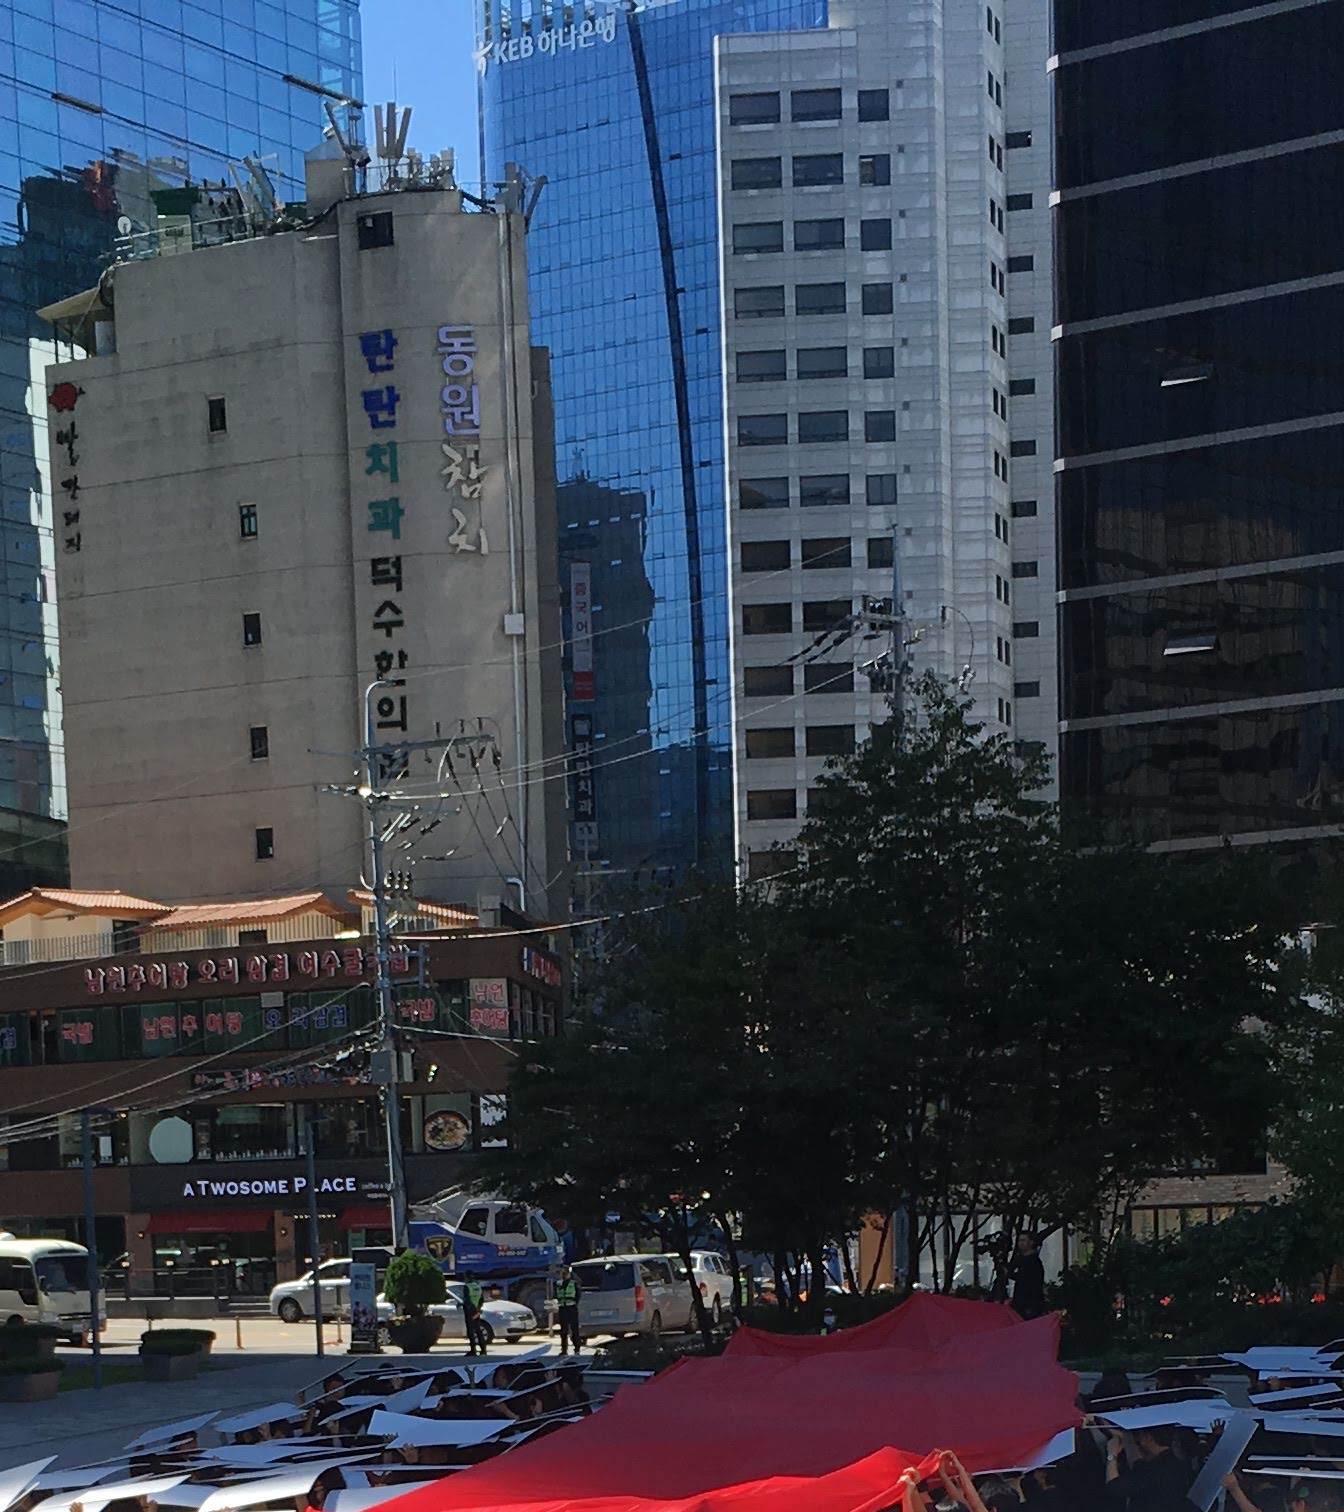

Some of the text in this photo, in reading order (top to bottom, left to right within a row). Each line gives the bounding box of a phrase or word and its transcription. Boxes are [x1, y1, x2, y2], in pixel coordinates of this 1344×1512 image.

[494, 13, 616, 65] KEB 하나은행
[359, 328, 405, 540] 탄탄치과
[437, 324, 489, 556] 동원참치
[198, 957, 240, 984] 오리
[473, 983, 504, 1002] 남원
[183, 1183, 195, 1197] A
[197, 1180, 289, 1196] TWOSOME
[294, 1177, 357, 1194] PACE
